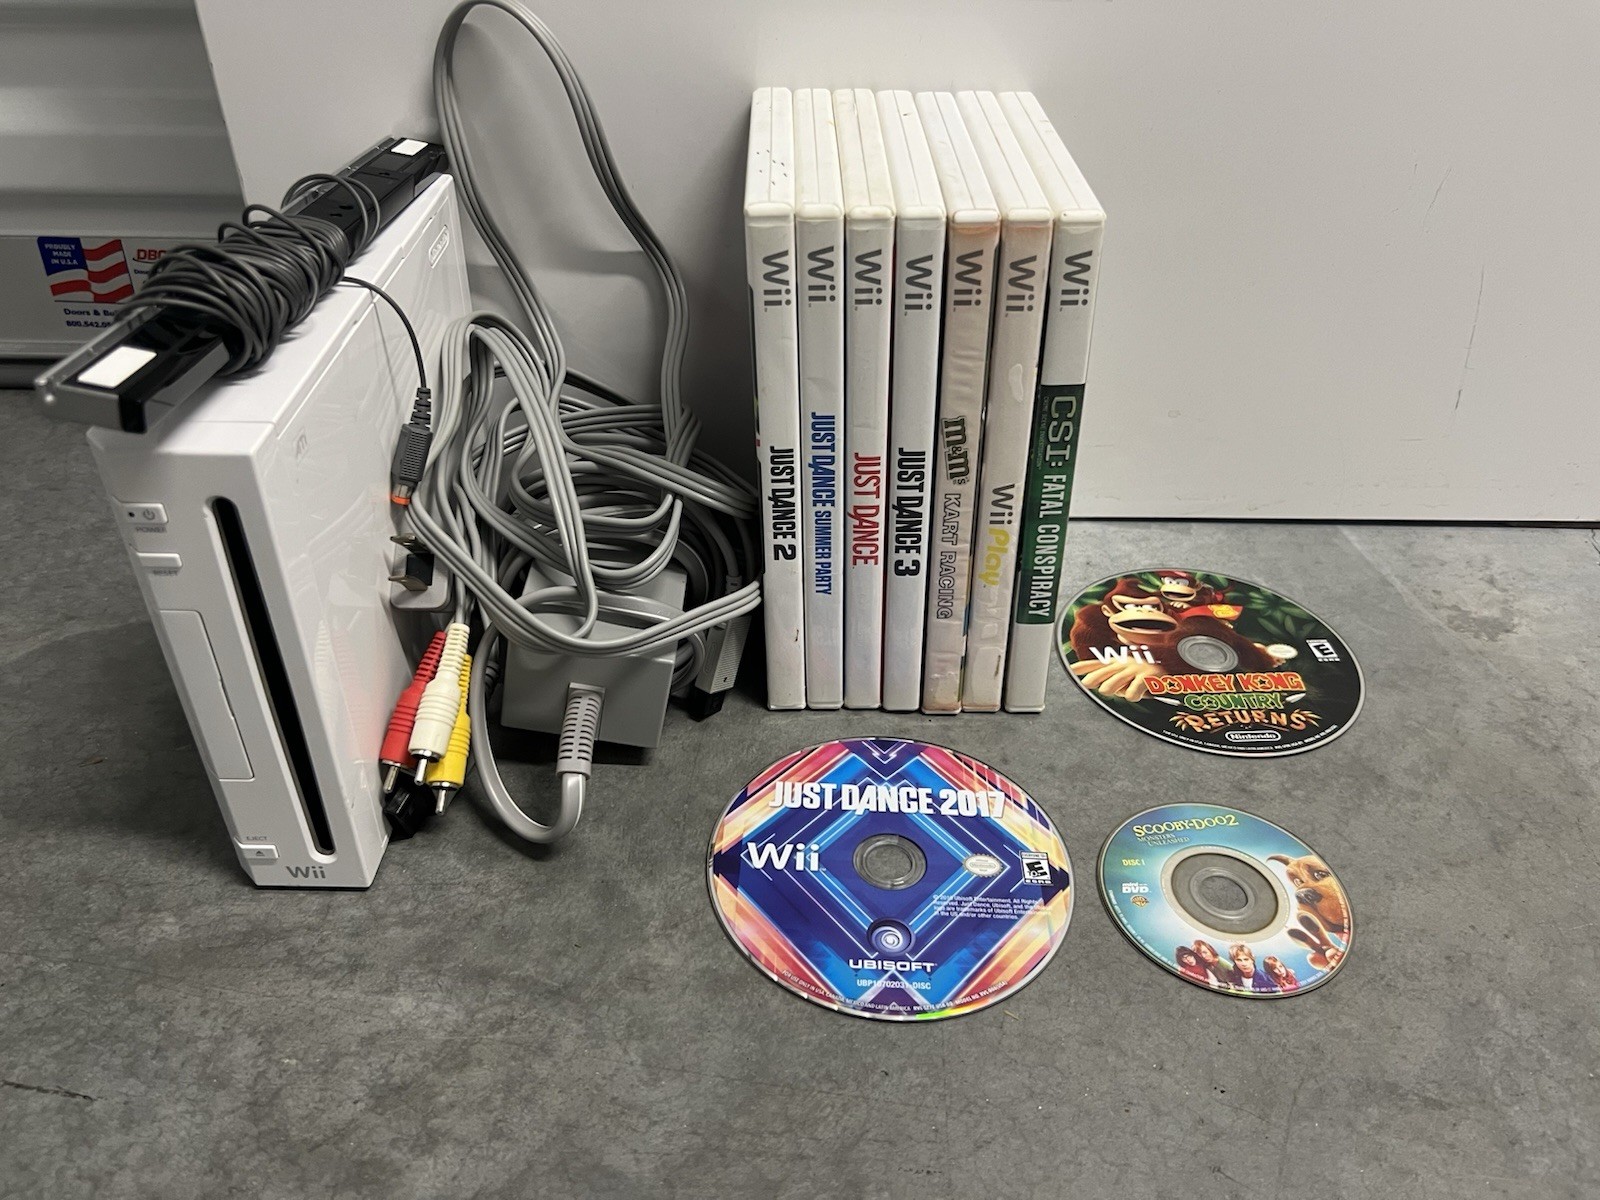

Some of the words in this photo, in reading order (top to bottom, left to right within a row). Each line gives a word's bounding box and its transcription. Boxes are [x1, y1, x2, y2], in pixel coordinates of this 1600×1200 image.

[762, 249, 792, 306] Wii
[807, 245, 836, 302] Wii
[854, 248, 883, 306] Wii
[904, 254, 934, 311] Wii
[953, 249, 984, 307] Wii
[1005, 254, 1038, 312] Wii
[1059, 250, 1094, 307] Wii
[811, 411, 836, 452] JUST
[1045, 396, 1077, 467] CSI:
[769, 445, 795, 485] JUST
[808, 455, 836, 508] DANCE
[853, 452, 881, 499] JUST
[896, 447, 926, 493] JUST
[768, 488, 797, 540] DANCE
[942, 493, 961, 545] KART
[989, 483, 1016, 525] Wii
[1039, 474, 1067, 519] FATAL
[814, 510, 832, 559] SUMMER
[847, 505, 880, 566] DANCE
[891, 496, 924, 555] DANCE
[773, 544, 797, 561] 2
[893, 559, 920, 577] 3
[978, 528, 1011, 586] Play
[1028, 524, 1061, 617] CONSPIRACY
[815, 561, 832, 595] PARTY
[936, 551, 957, 619] RACING
[1089, 644, 1157, 665] Wii
[1313, 643, 1335, 656] E
[1143, 673, 1237, 694] DONKEY
[1236, 671, 1306, 692] KONG
[1183, 692, 1285, 711] COUNTRY
[1184, 708, 1308, 733] RETURNS
[1229, 732, 1277, 740] Nintendo
[768, 780, 838, 811] JUST
[841, 784, 935, 816] DANCE
[940, 788, 1006, 818] 2017
[747, 841, 820, 872] Wii
[1137, 833, 1176, 842] MONSTERS
[1147, 836, 1190, 847] UNLEASHED
[285, 865, 326, 879] Wii
[1025, 860, 1048, 877] E
[849, 959, 935, 972] UBISOFT
